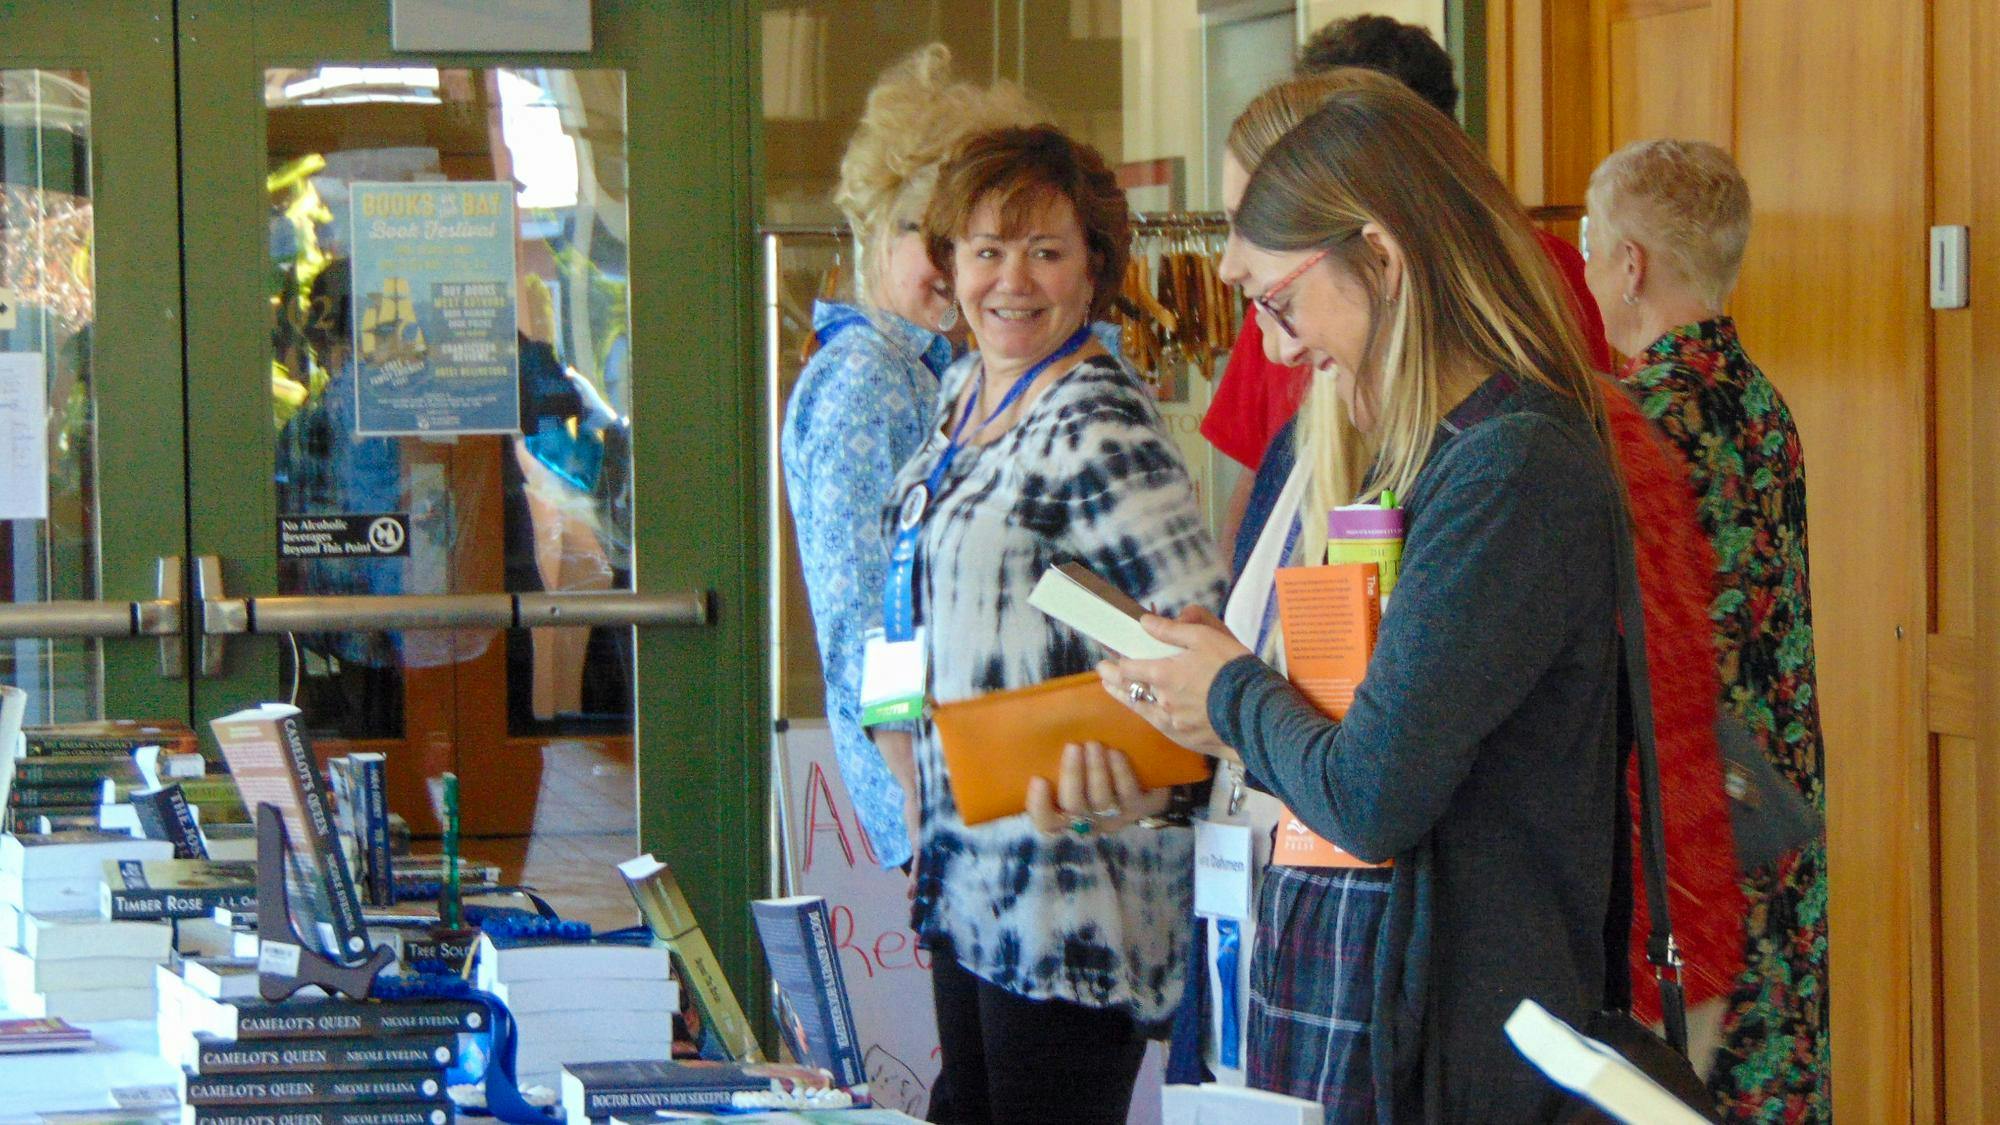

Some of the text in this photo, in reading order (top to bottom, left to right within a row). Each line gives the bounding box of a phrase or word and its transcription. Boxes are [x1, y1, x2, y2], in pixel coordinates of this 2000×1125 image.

[362, 192, 436, 218] BOOKS
[463, 192, 502, 217] BAY
[369, 219, 497, 240] Book Festival
[282, 519, 348, 531] No Alcoholic
[282, 532, 333, 544] Beverages
[283, 541, 371, 555] Beyond This Point
[1366, 575, 1376, 595] The
[281, 717, 316, 791] CAMELOT'S
[305, 792, 329, 836] QUEEN
[115, 896, 162, 912] TIMBER
[166, 895, 203, 911] ROSE
[409, 943, 436, 957] TREE
[241, 1015, 460, 1031] CAMELOT'S QUEEN NICOLE EVELINA
[203, 1050, 428, 1066] CAMELOT'S QUEEN NICOLE EVELINA
[190, 1082, 416, 1098] CAMELOT'S QUEEN NICOLE EVELINA
[592, 1094, 629, 1107] DOCTOR
